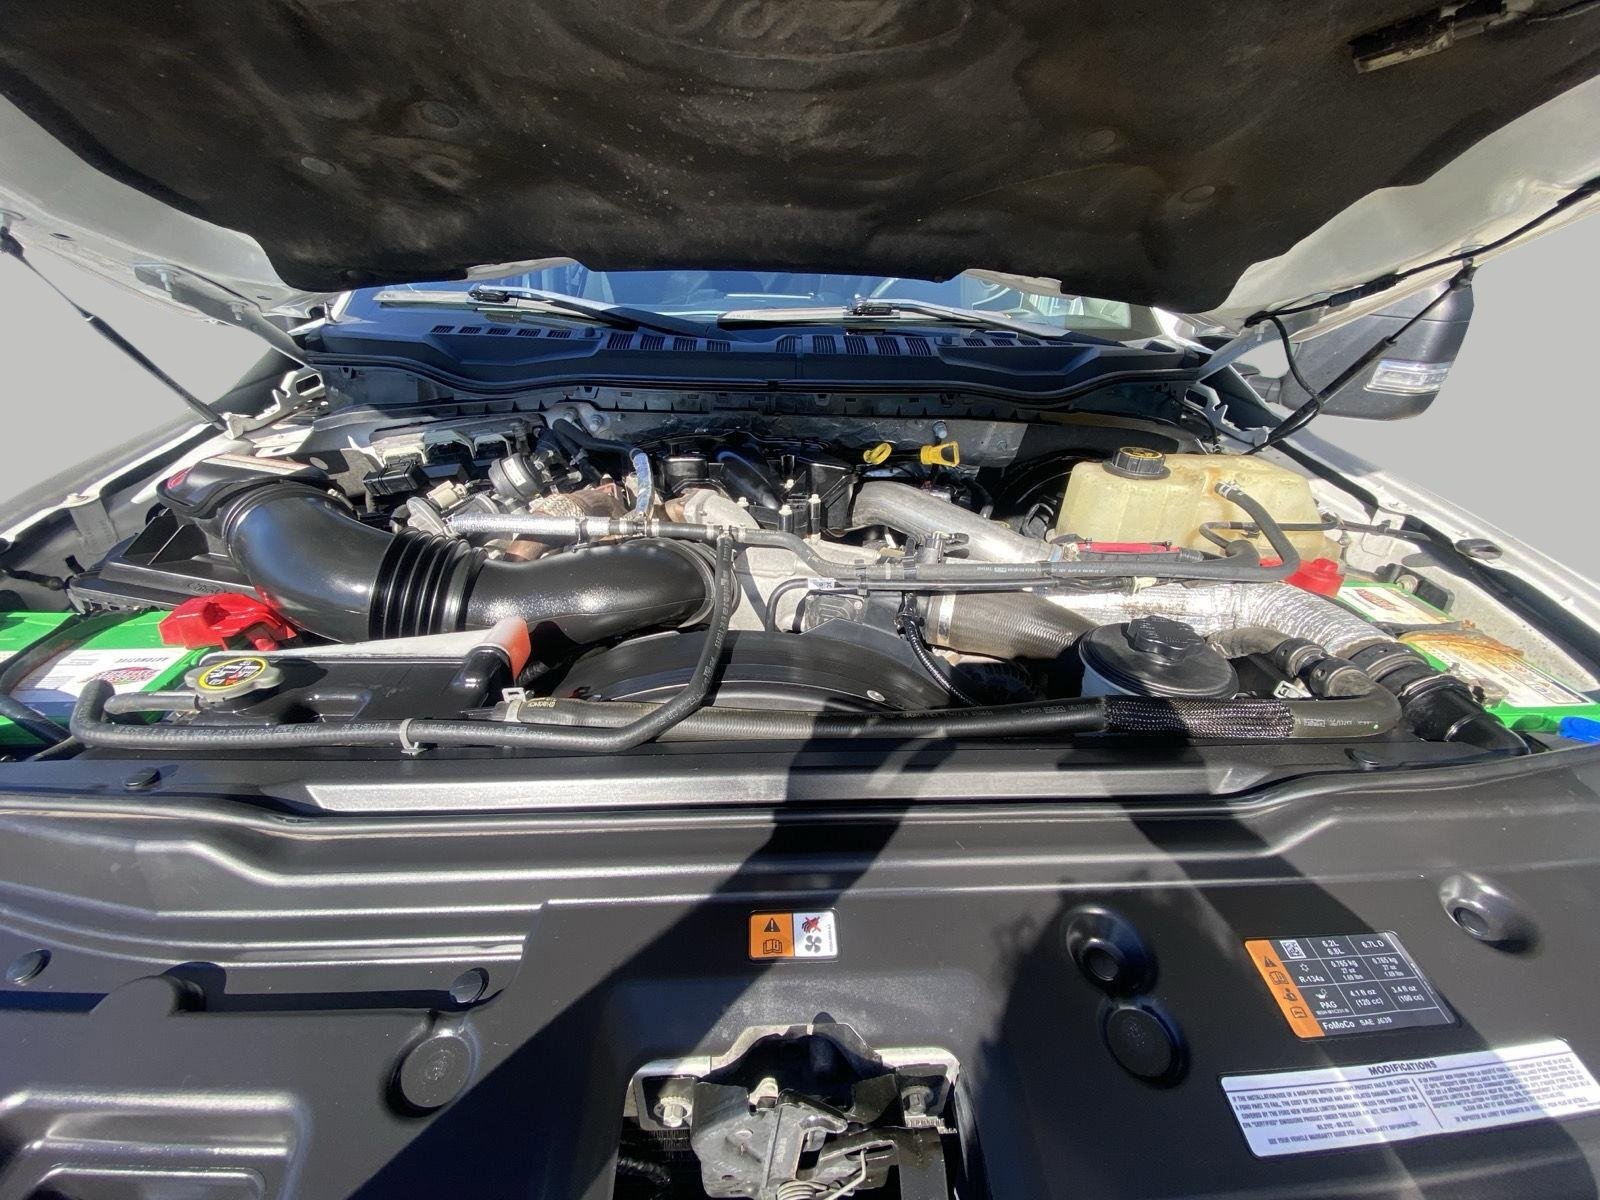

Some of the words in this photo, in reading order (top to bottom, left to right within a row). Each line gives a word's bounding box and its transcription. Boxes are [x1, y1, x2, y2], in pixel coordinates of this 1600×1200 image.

[1299, 975, 1325, 983] R-134a
[1323, 1021, 1355, 1030] FoMoCo
[1369, 1061, 1436, 1075] MODIFICATIONS
